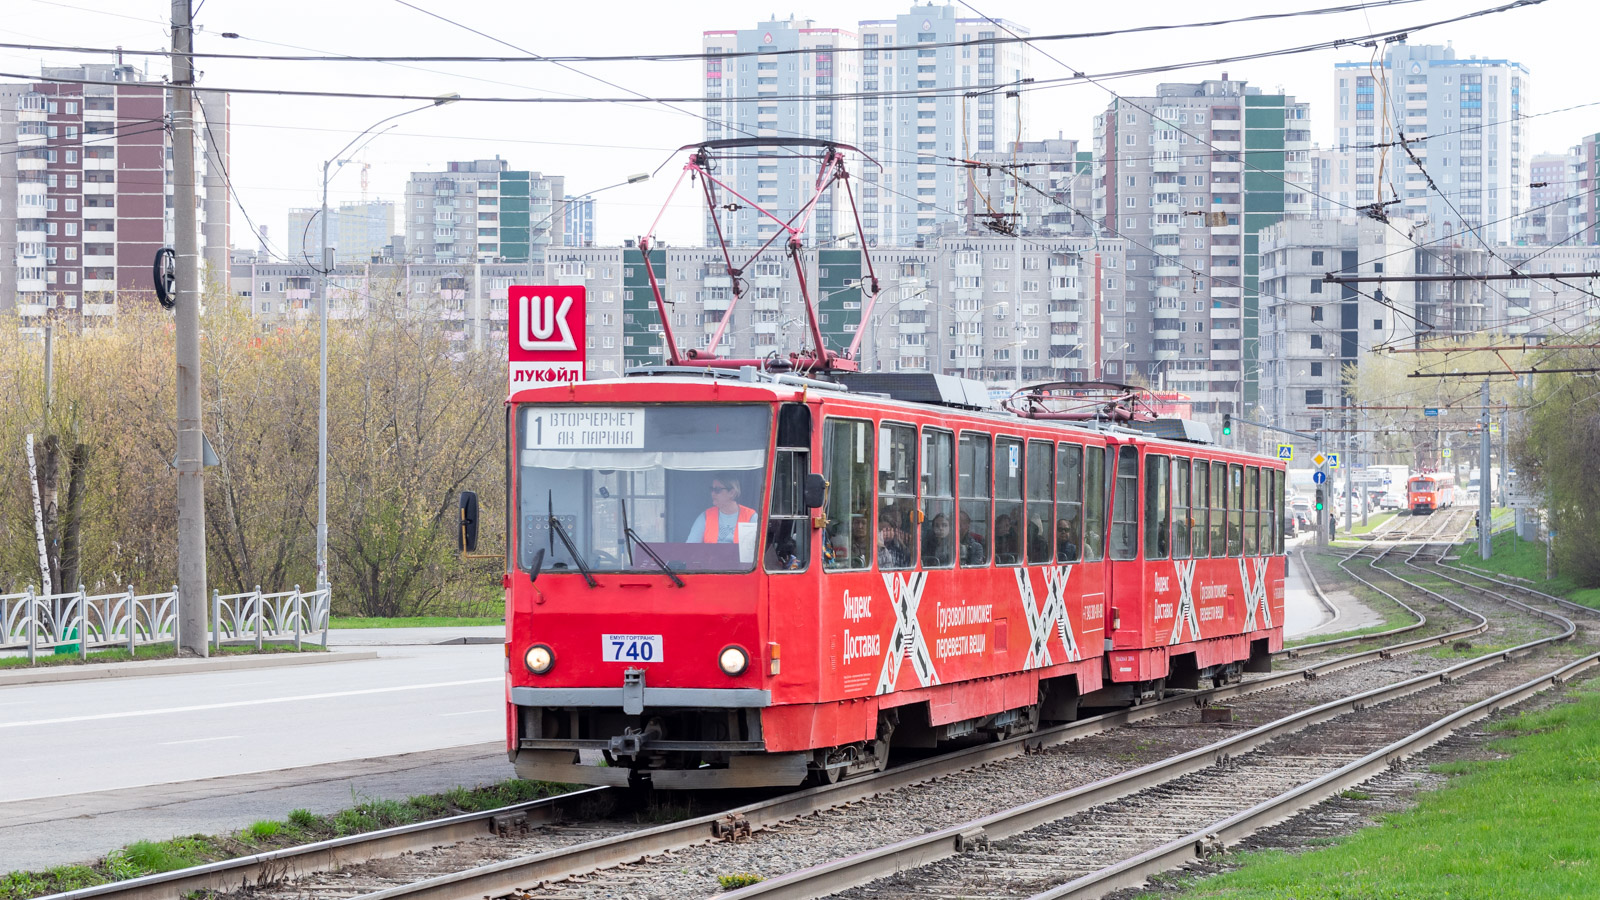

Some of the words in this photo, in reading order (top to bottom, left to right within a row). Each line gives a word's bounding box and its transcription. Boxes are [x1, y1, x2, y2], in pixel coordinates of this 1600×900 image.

[513, 366, 579, 382] ЛУКОЙЛ
[534, 416, 543, 446] 1
[550, 412, 636, 427] ВТОРЧЕРМЕТ
[843, 589, 872, 623] Яндекс
[936, 599, 966, 634] Грузовой
[966, 604, 993, 625] поможет
[612, 641, 653, 661] 740
[843, 629, 881, 665] Доставка
[936, 635, 969, 664] перевезти
[969, 633, 986, 657] вещи
